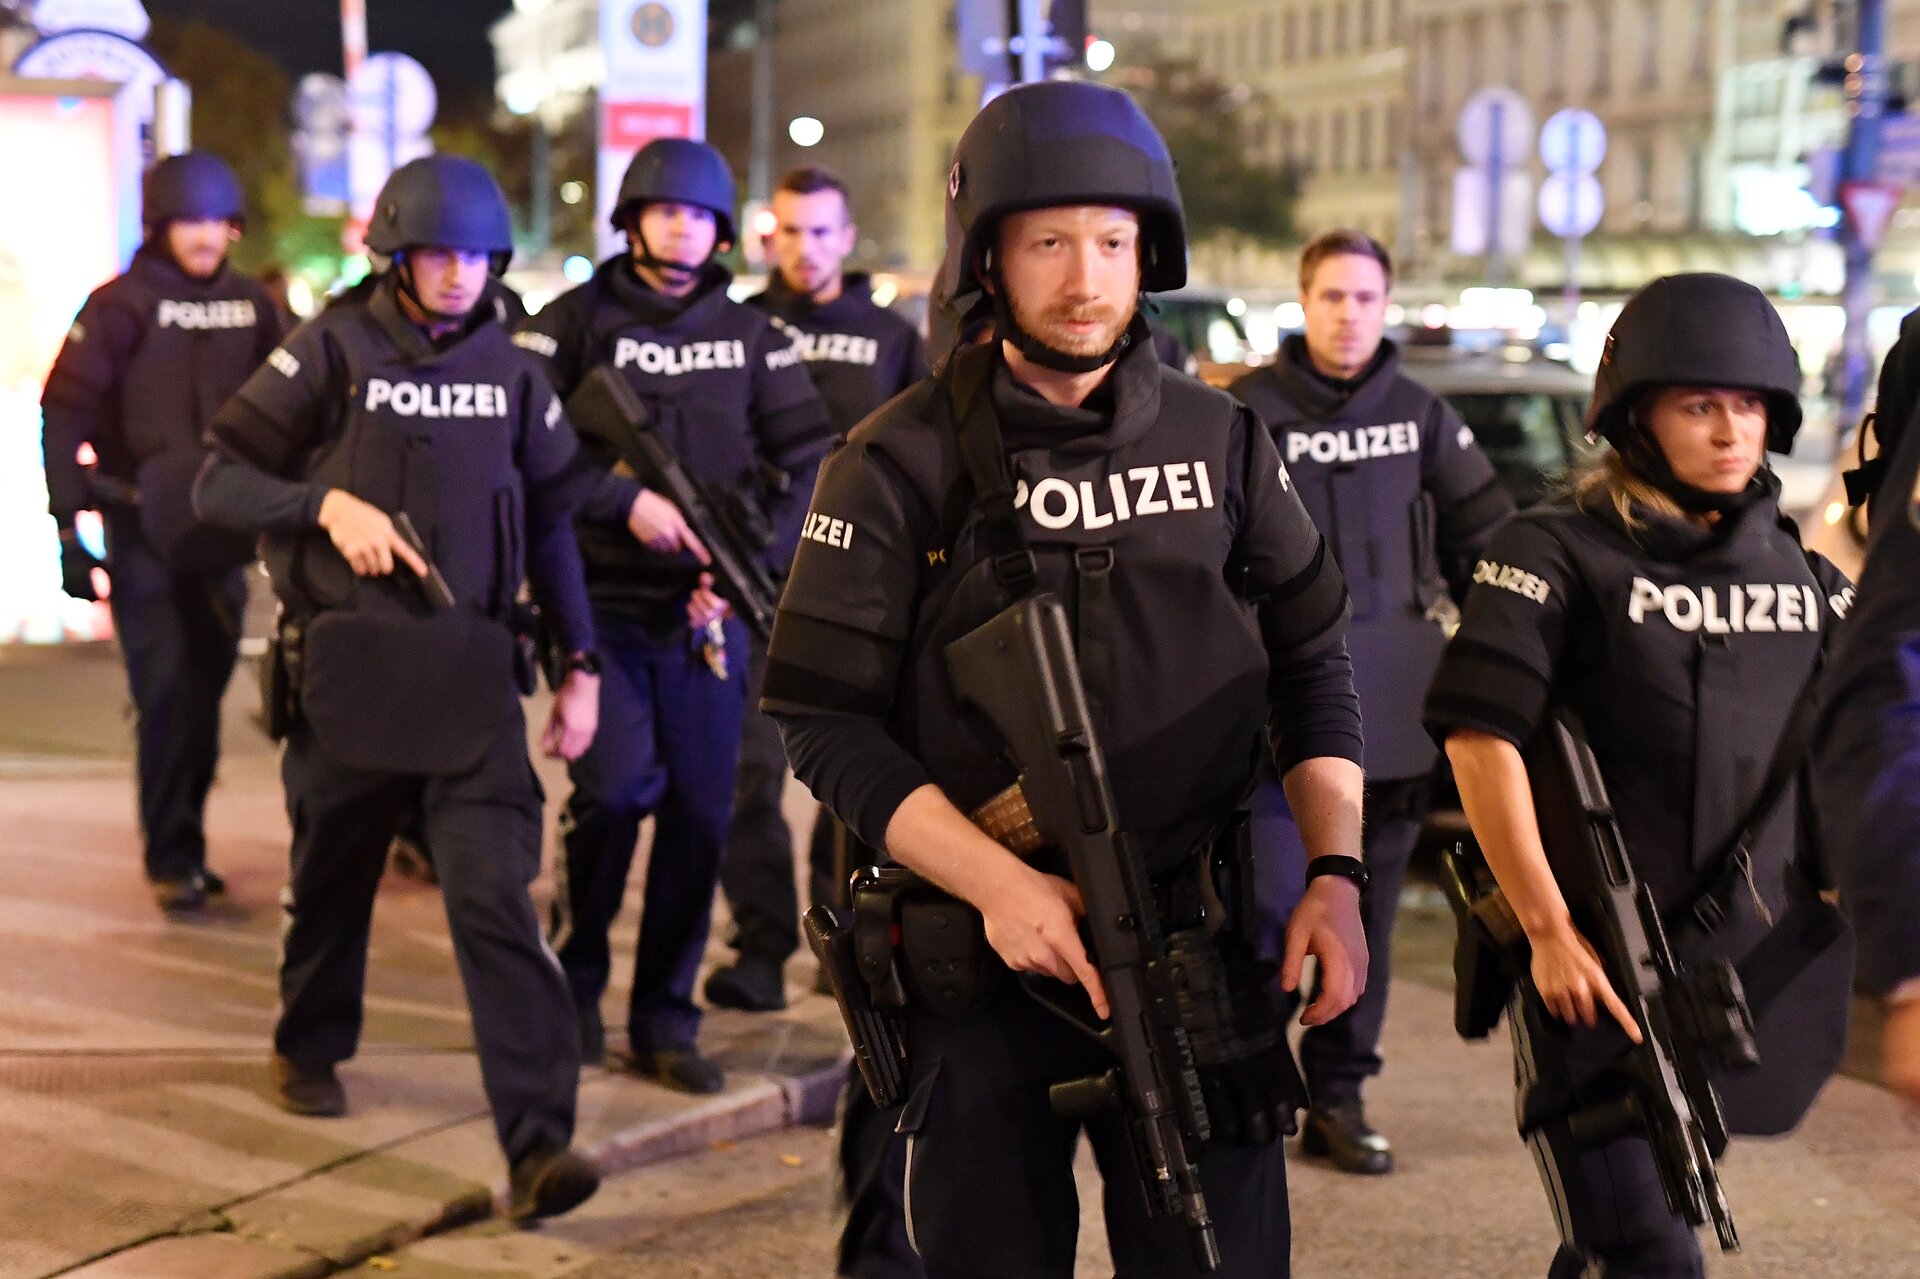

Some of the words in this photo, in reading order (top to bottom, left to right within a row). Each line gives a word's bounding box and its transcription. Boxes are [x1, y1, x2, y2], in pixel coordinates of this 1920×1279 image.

[614, 337, 746, 377] POLIZEI
[365, 378, 508, 418] POLIZEI
[1287, 420, 1420, 463] POLIZEI
[1627, 576, 1819, 634] POLIZEI
